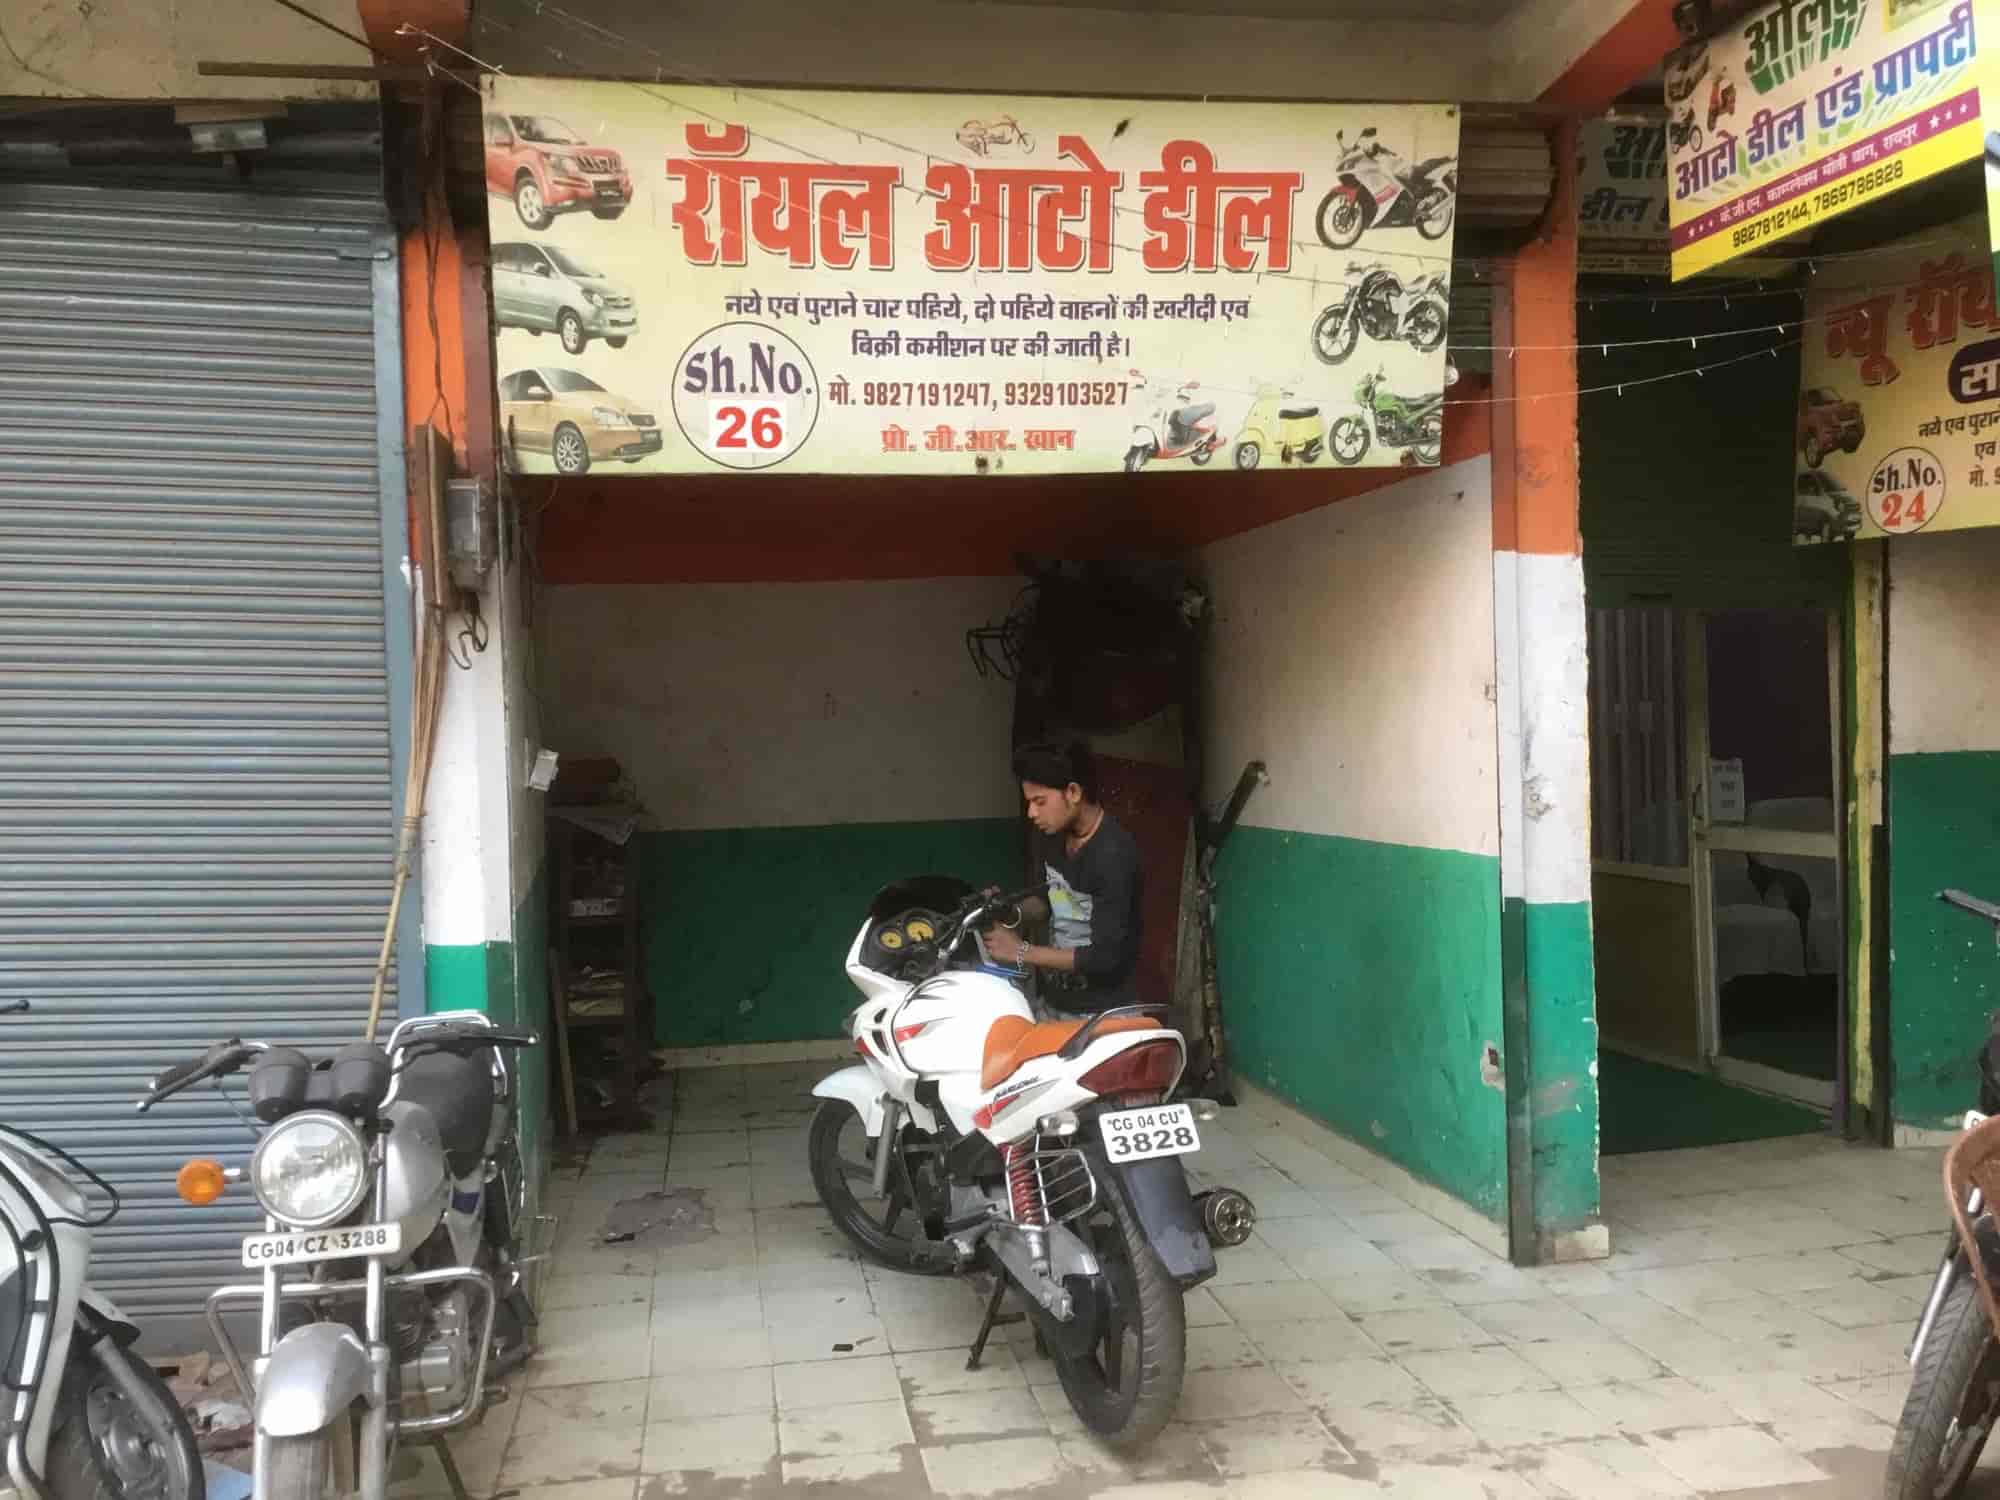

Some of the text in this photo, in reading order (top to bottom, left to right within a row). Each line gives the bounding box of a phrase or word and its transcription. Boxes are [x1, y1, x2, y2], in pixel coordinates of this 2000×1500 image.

[1675, 129, 1738, 200] आटो
[1746, 105, 1808, 166] डील
[1816, 67, 1864, 128] एंड
[666, 123, 1304, 272] रॉयल आटो डील
[725, 288, 761, 316] नये
[805, 291, 858, 325] पुराने
[863, 298, 900, 319] चार
[906, 292, 968, 325] पहिये,
[974, 293, 996, 323] दो
[1000, 292, 1055, 320] पहिये
[1060, 294, 1119, 320] वाहनों
[1123, 293, 1149, 320] की
[1153, 293, 1217, 323] खरीदी
[906, 331, 985, 357] कमीशन
[991, 338, 1018, 357] पर
[1023, 331, 1050, 357] की
[1055, 331, 1104, 358] जाती
[828, 375, 1129, 412] मो. 9827191247, 9329103527
[716, 406, 783, 449] 26
[1023, 430, 1076, 452] खान
[1881, 489, 1926, 527] 24
[1112, 1111, 1179, 1131] CG 04 CU
[1111, 1127, 1194, 1155] 3828
[248, 1228, 387, 1260] CG04 CZ 3288
